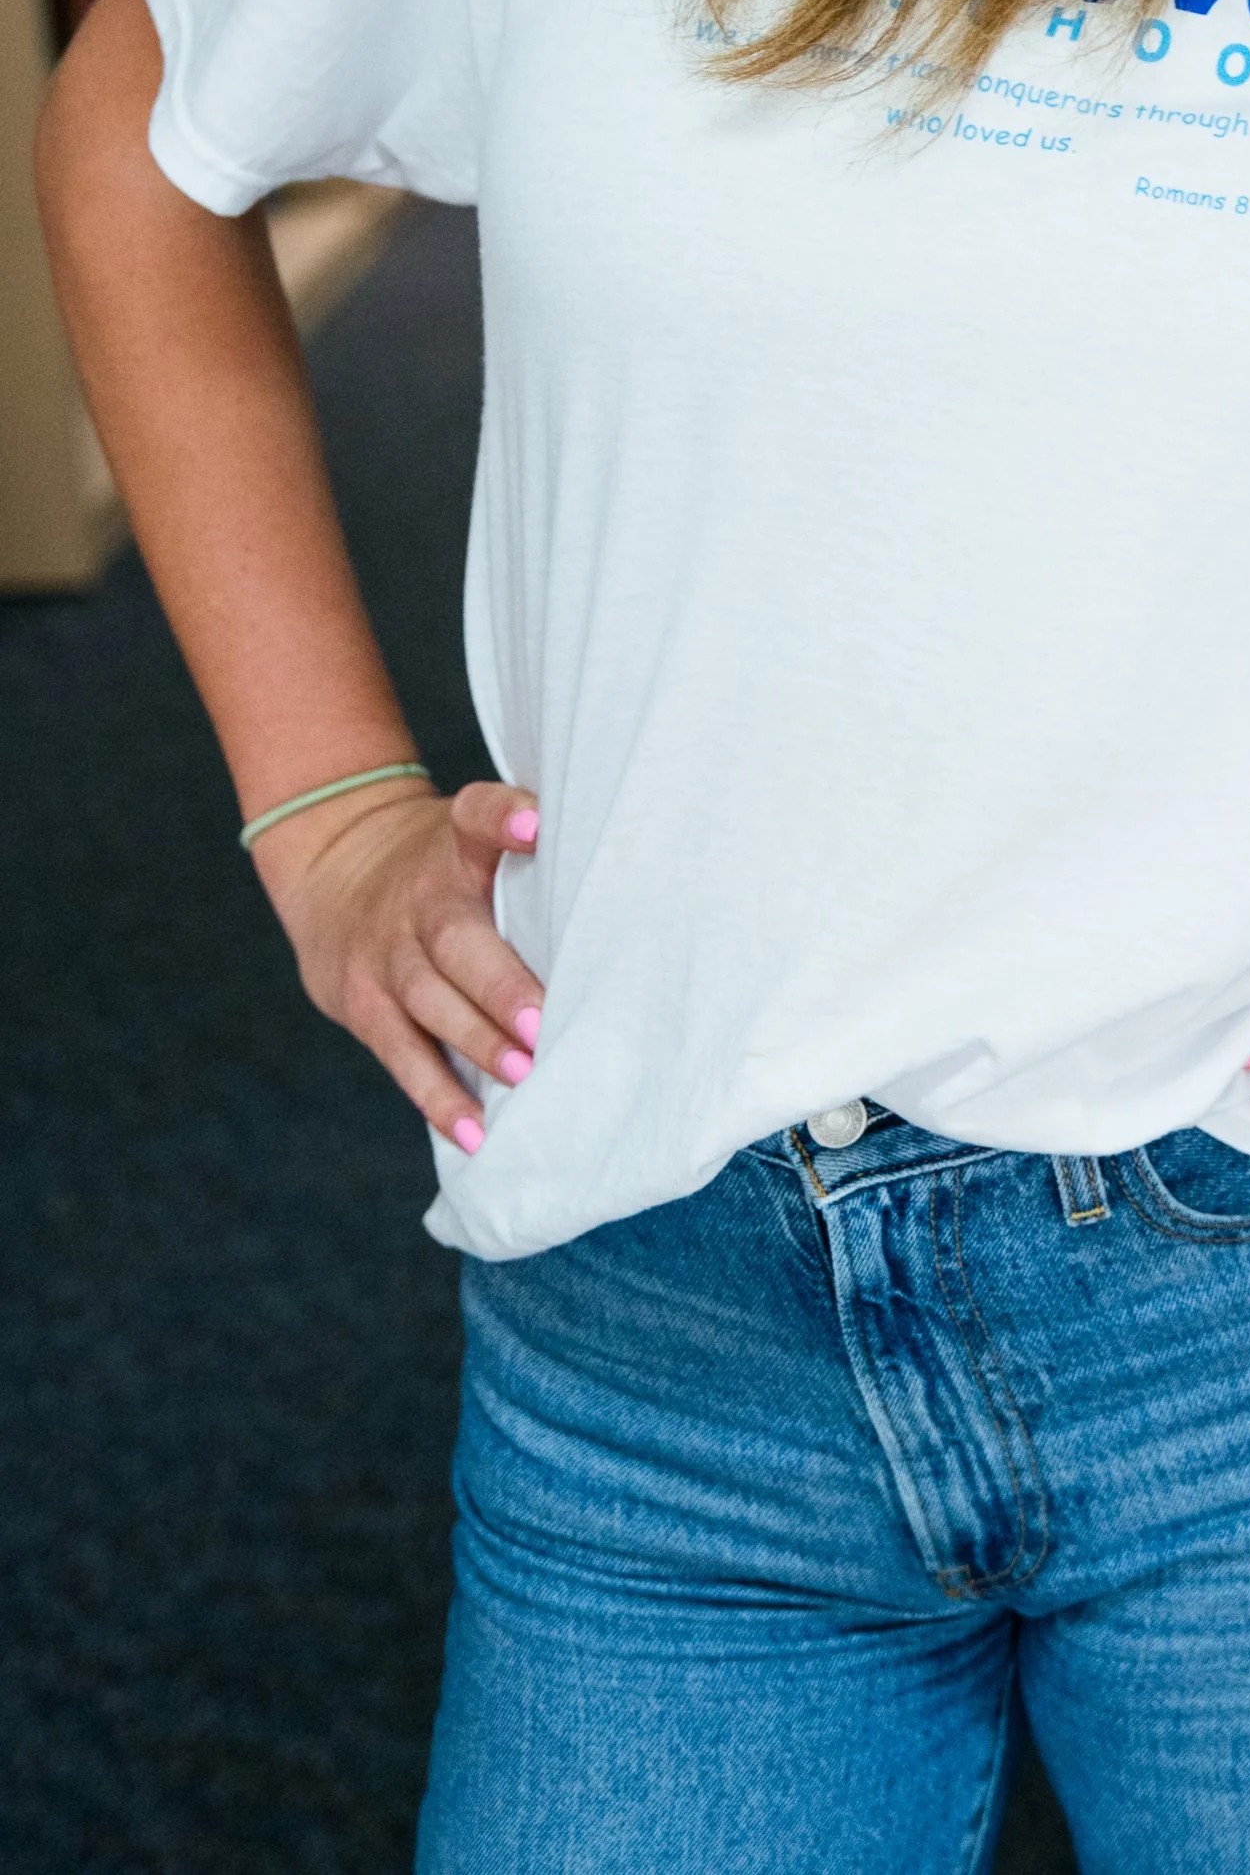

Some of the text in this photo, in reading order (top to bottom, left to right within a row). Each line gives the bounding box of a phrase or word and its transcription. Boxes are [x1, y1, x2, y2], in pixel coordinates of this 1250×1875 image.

[966, 75, 1124, 119] onquerors
[1135, 104, 1250, 138] through
[953, 113, 1033, 148] loved
[1040, 135, 1077, 154] us.
[1135, 176, 1227, 210] Romans
